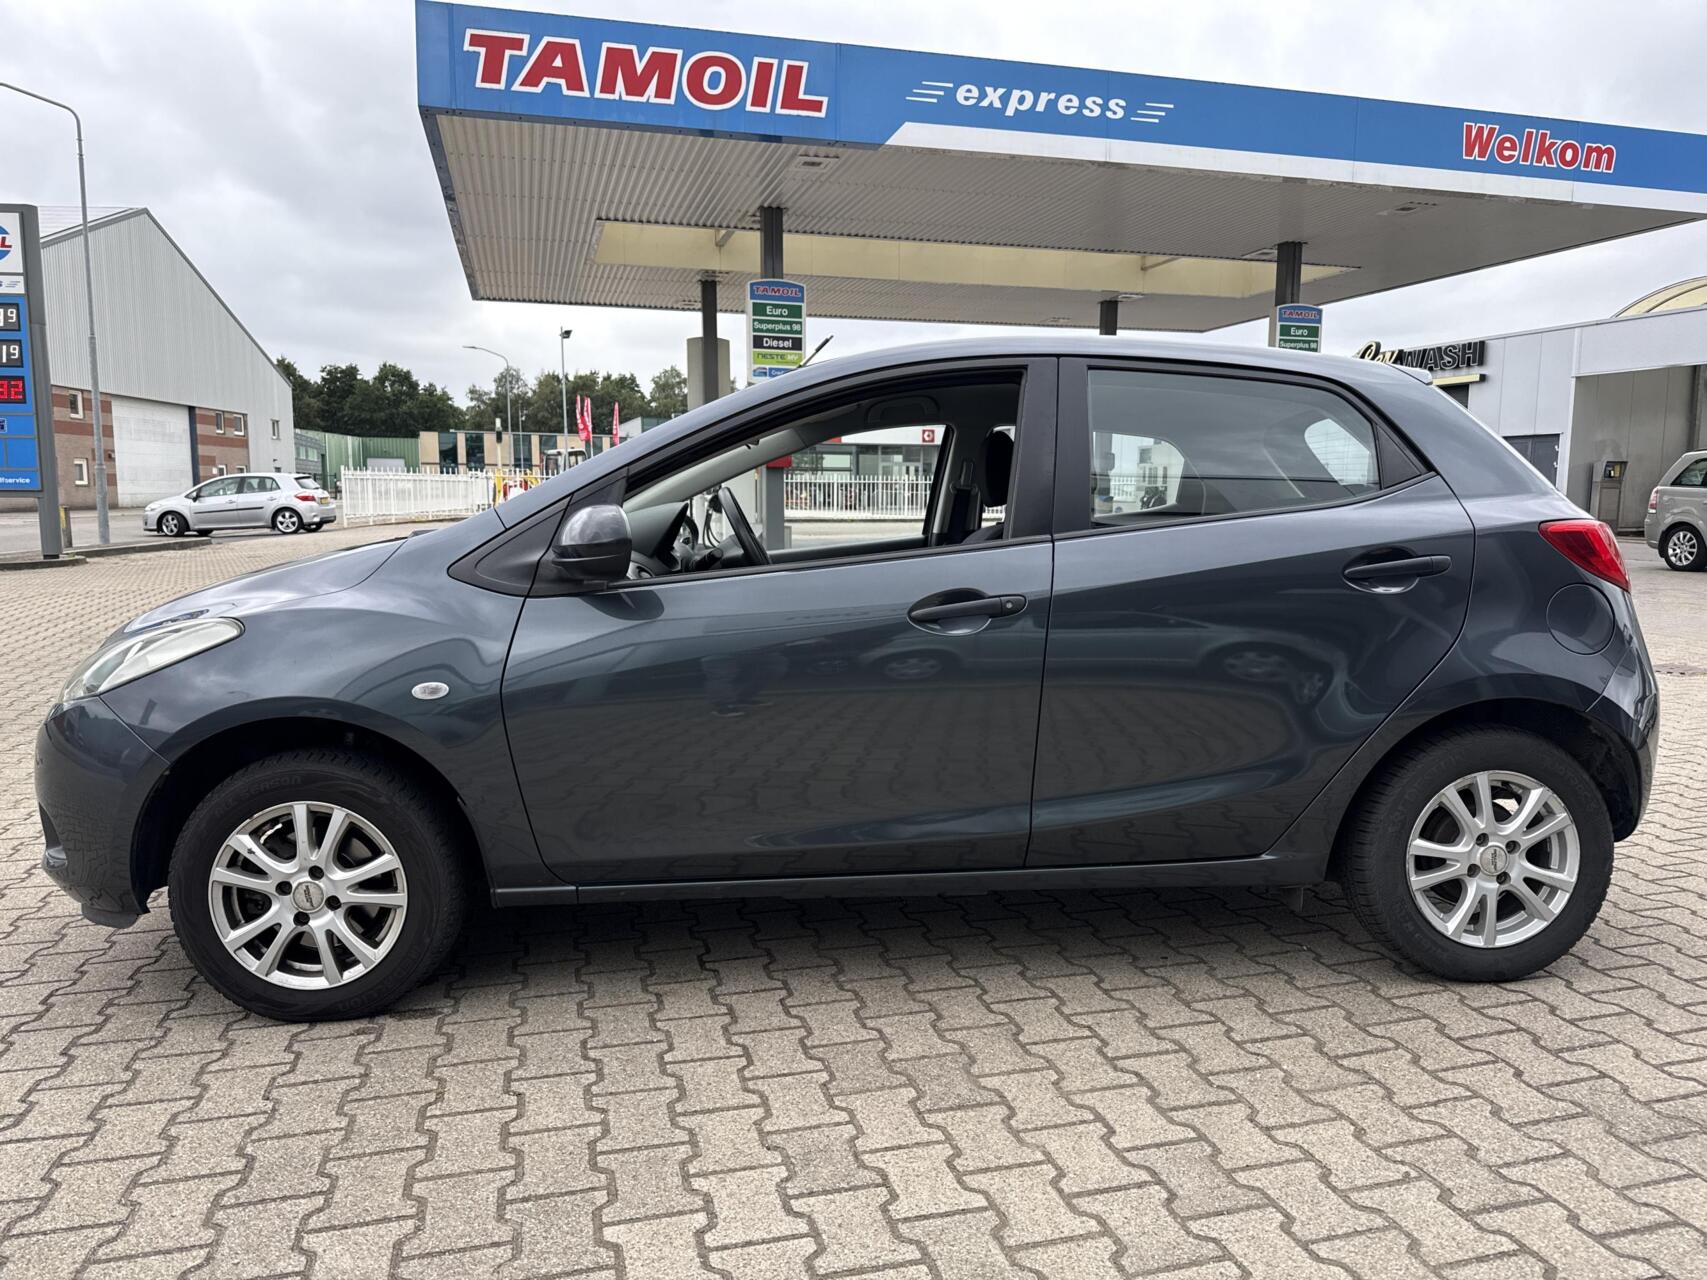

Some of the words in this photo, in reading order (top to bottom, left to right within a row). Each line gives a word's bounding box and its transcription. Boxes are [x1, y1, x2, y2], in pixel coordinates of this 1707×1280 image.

[463, 28, 829, 118] TAMOIL
[956, 83, 1127, 119] express
[1462, 122, 1617, 173] Welkom
[753, 285, 801, 297] TAMOIL
[766, 305, 788, 316] Euro
[1282, 310, 1320, 319] TAMOIL
[753, 321, 790, 331] Superplus
[792, 323, 801, 331] 98
[1290, 327, 1308, 336] Euro
[763, 338, 792, 348] Diesel
[1402, 340, 1485, 371] WASH
